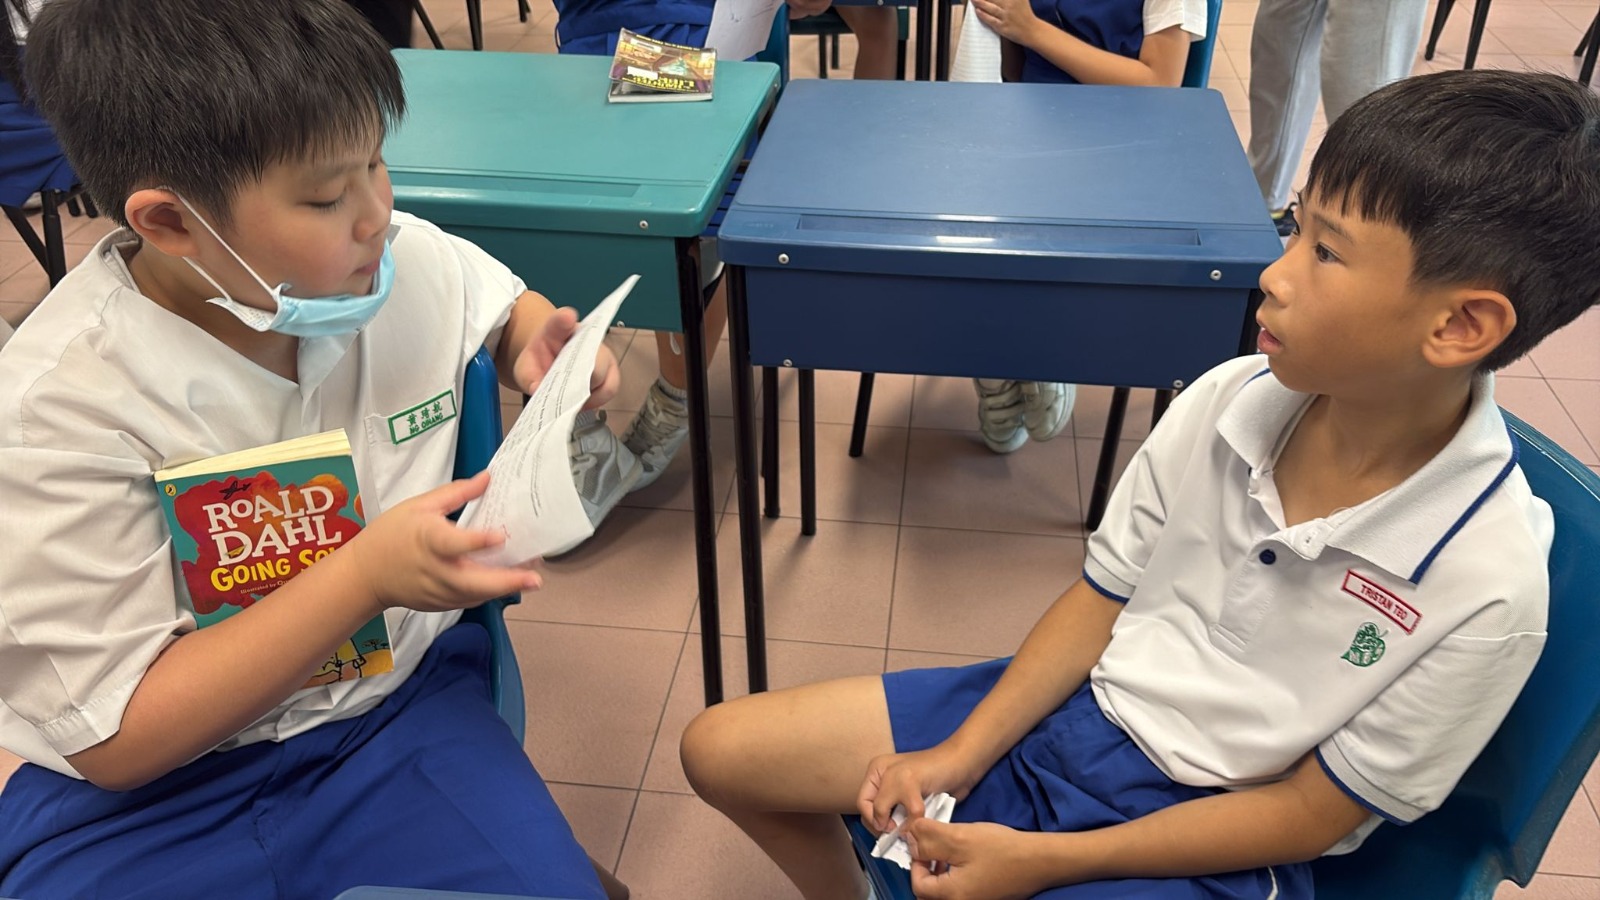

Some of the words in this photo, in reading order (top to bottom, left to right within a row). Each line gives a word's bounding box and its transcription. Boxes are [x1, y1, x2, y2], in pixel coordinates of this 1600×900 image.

[409, 424, 420, 434] NG
[202, 486, 334, 533] ROALD
[211, 515, 342, 566] DAHL
[210, 558, 291, 592] GOING
[1360, 584, 1393, 611] TRISTAN
[1393, 605, 1408, 621] TEO
